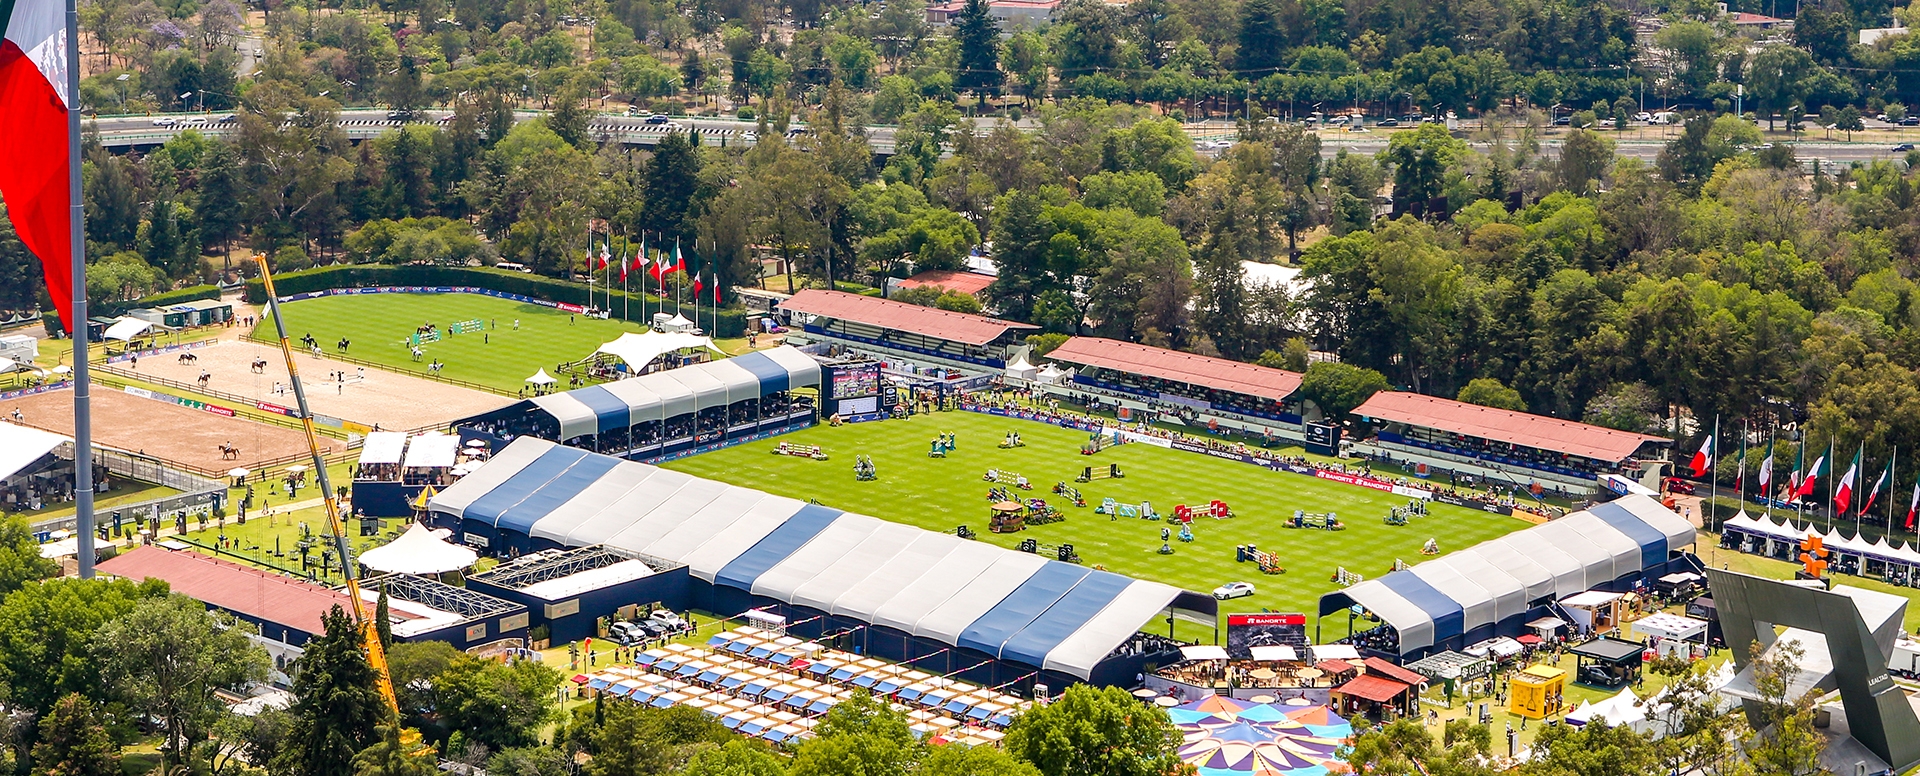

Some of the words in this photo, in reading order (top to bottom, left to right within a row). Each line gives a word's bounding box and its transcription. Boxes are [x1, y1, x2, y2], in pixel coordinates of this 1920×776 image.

[1325, 473, 1353, 484] BANORTE
[1363, 481, 1391, 492] BANORTE
[1614, 481, 1628, 493] GNP
[1469, 661, 1486, 675] GNP
[1868, 673, 1888, 686] LEALTAD
